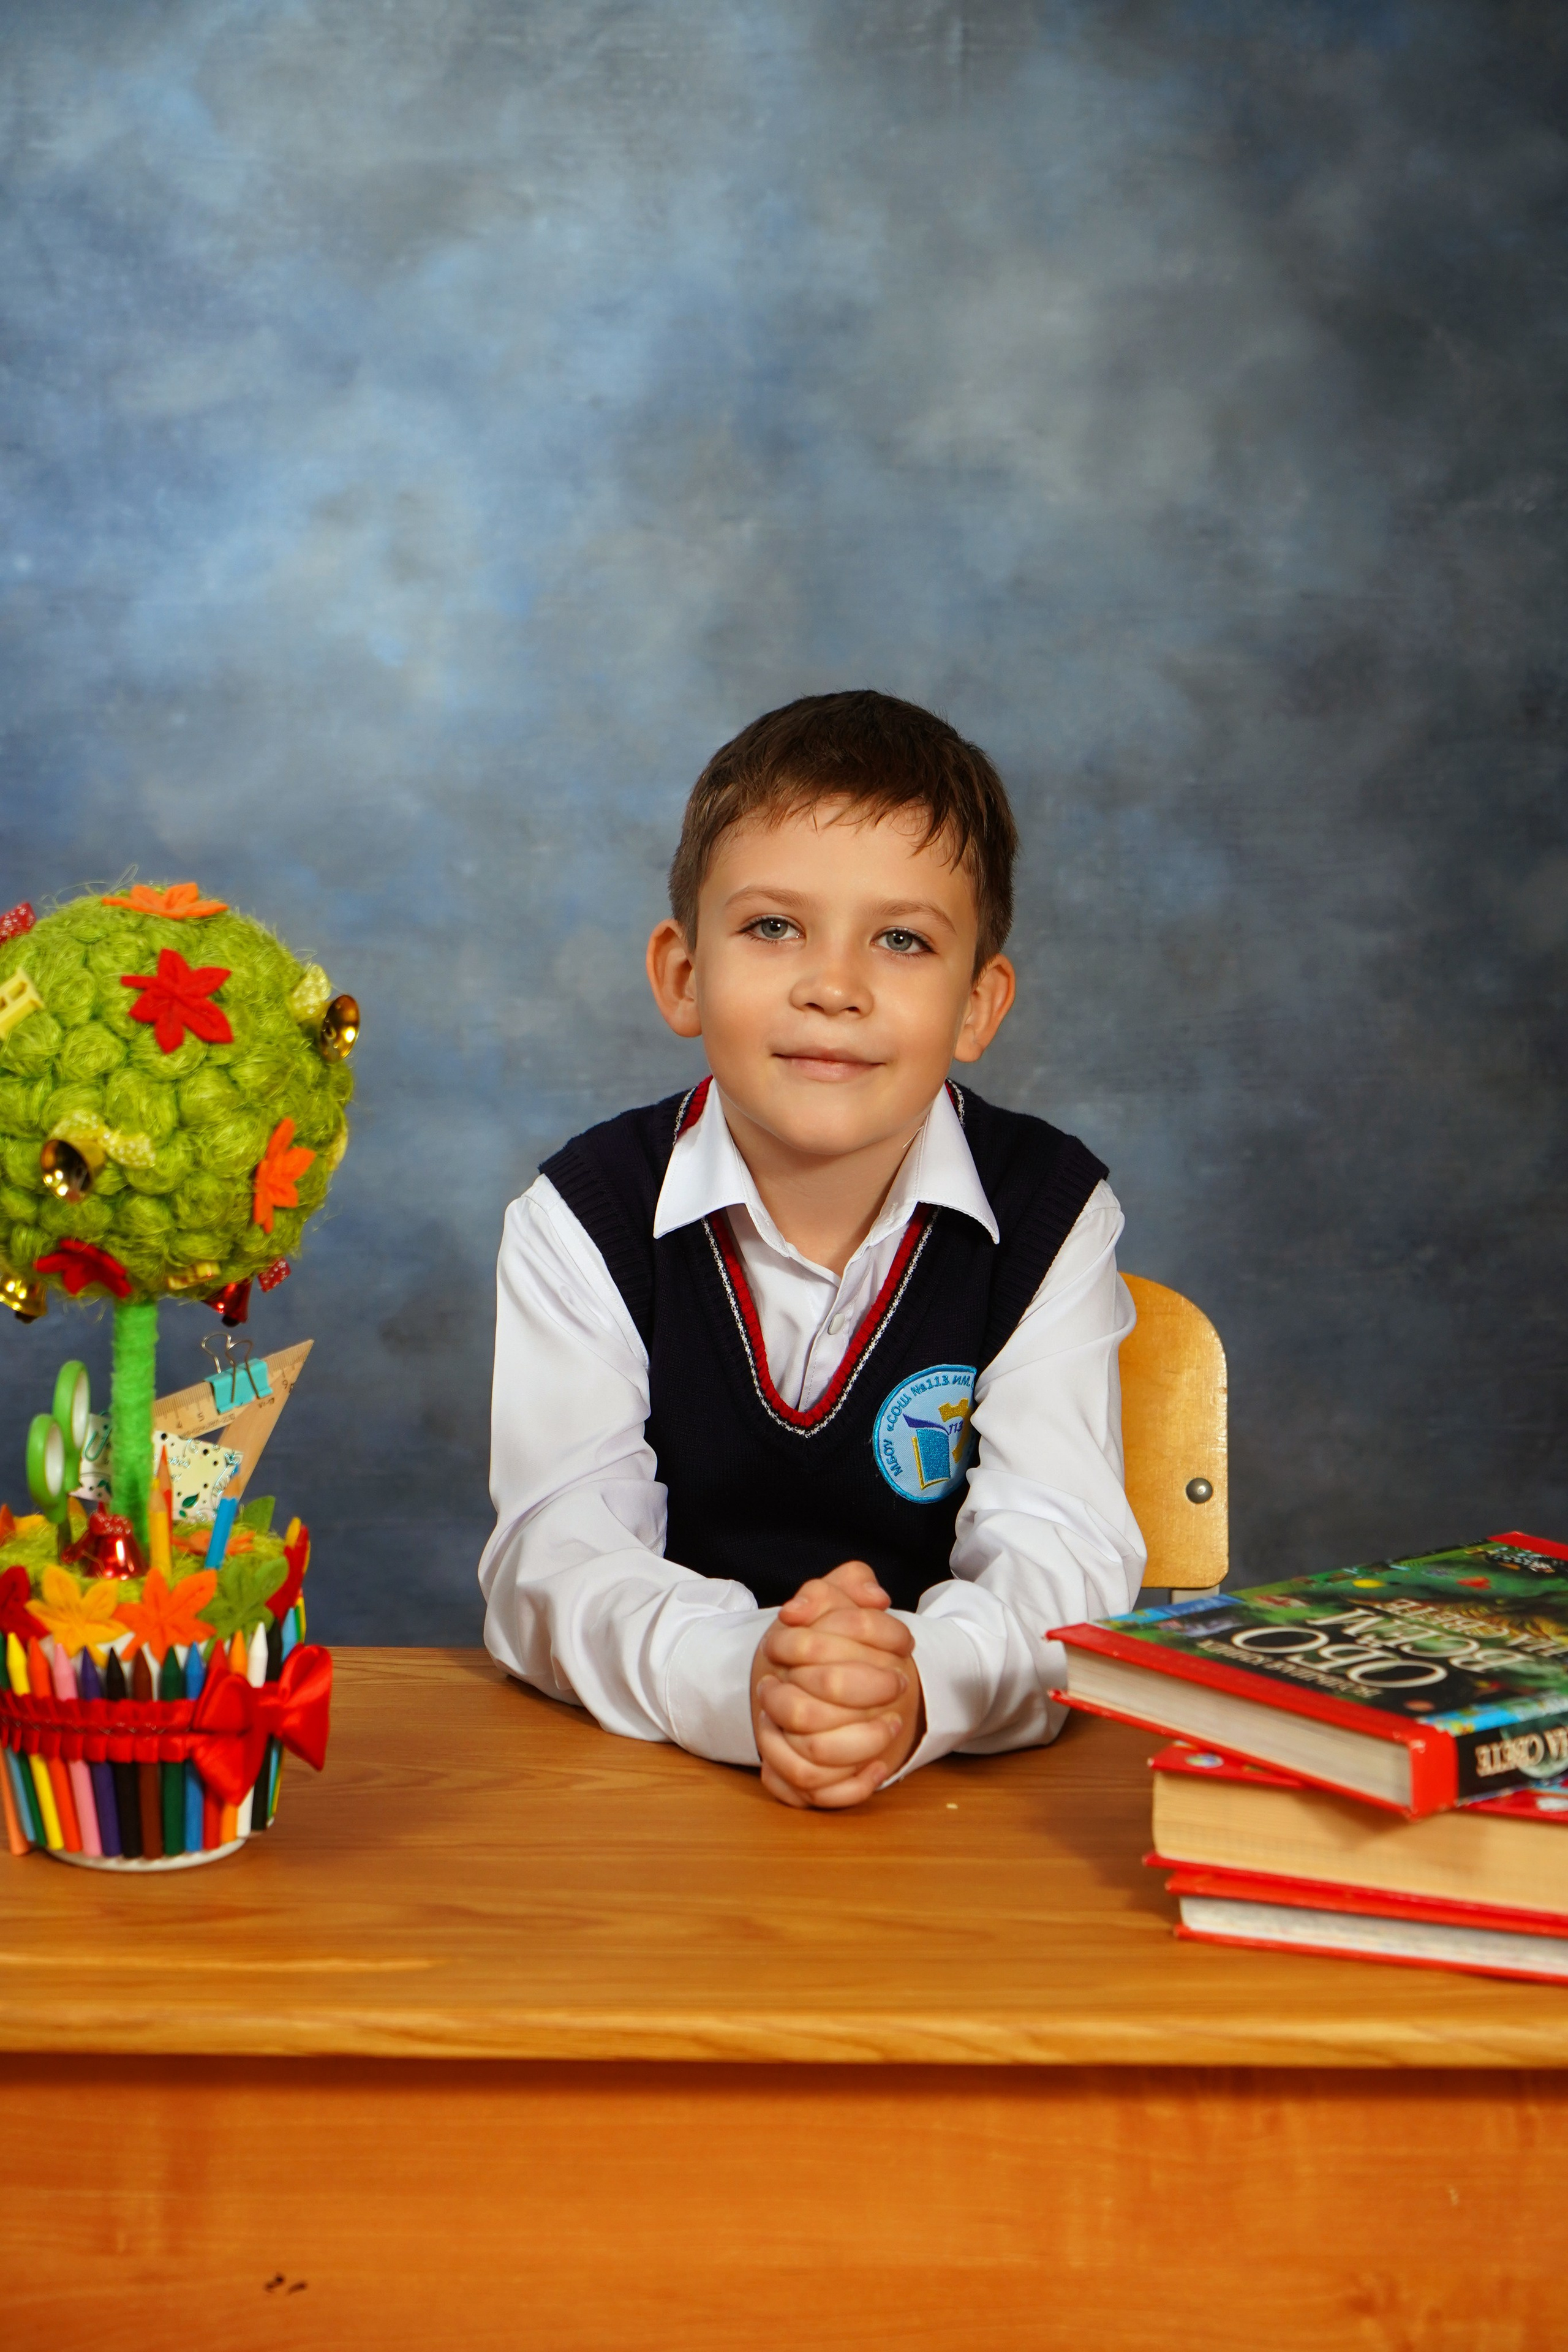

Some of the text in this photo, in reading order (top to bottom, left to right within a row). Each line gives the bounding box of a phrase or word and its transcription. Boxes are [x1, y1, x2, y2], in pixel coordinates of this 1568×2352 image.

[282, 1381, 288, 1390] 9
[198, 1412, 204, 1422] 5
[883, 1439, 903, 1477] МБОУ
[910, 1376, 950, 1396] №113
[949, 1420, 963, 1434] 113
[1381, 1598, 1511, 1638] СВЕТЕ
[1231, 1626, 1447, 1688] ОБО
[1305, 1608, 1533, 1673] ВСЁМ
